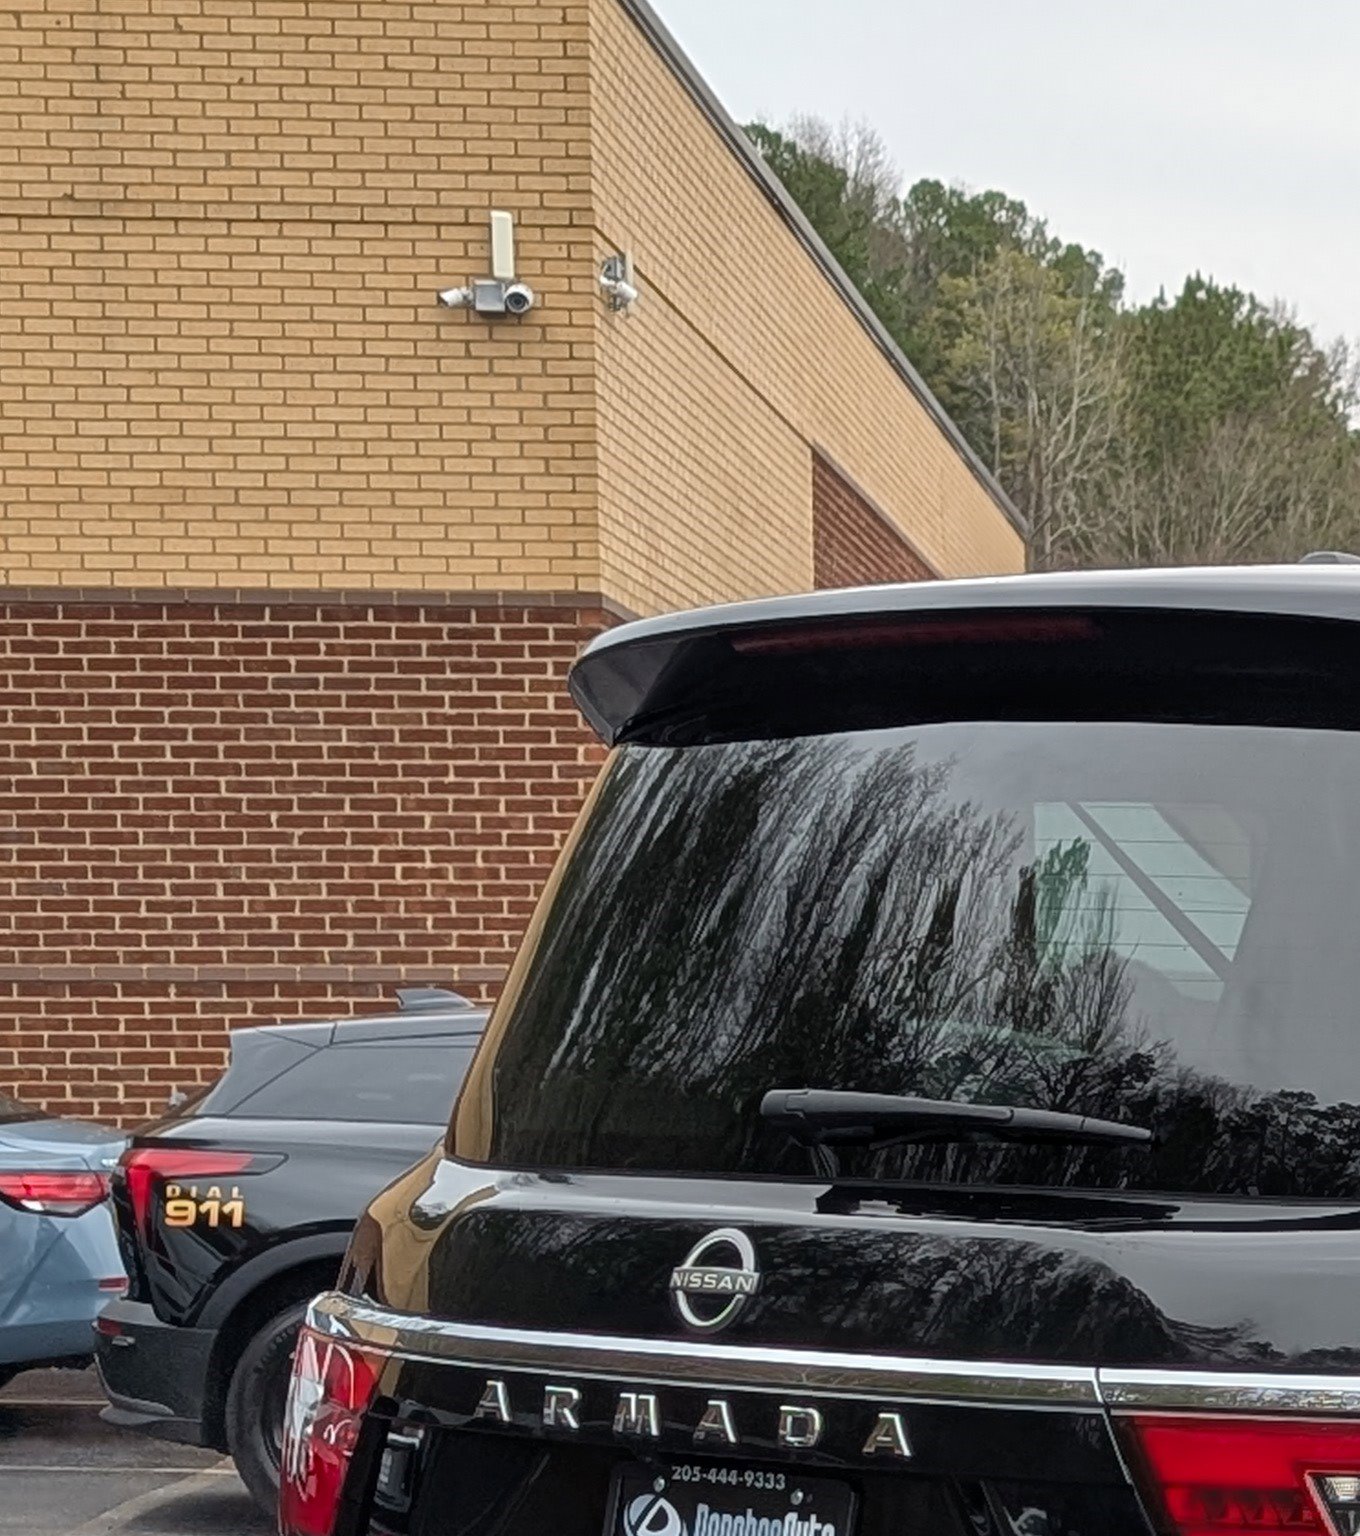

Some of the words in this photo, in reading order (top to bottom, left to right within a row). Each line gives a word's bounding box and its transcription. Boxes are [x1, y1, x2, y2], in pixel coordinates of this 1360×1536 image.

[165, 1184, 244, 1199] DIAL
[164, 1199, 244, 1228] 911
[670, 1270, 757, 1294] NISSAN
[473, 1380, 913, 1459] ARMADA
[671, 1465, 787, 1490] 205-444-9333
